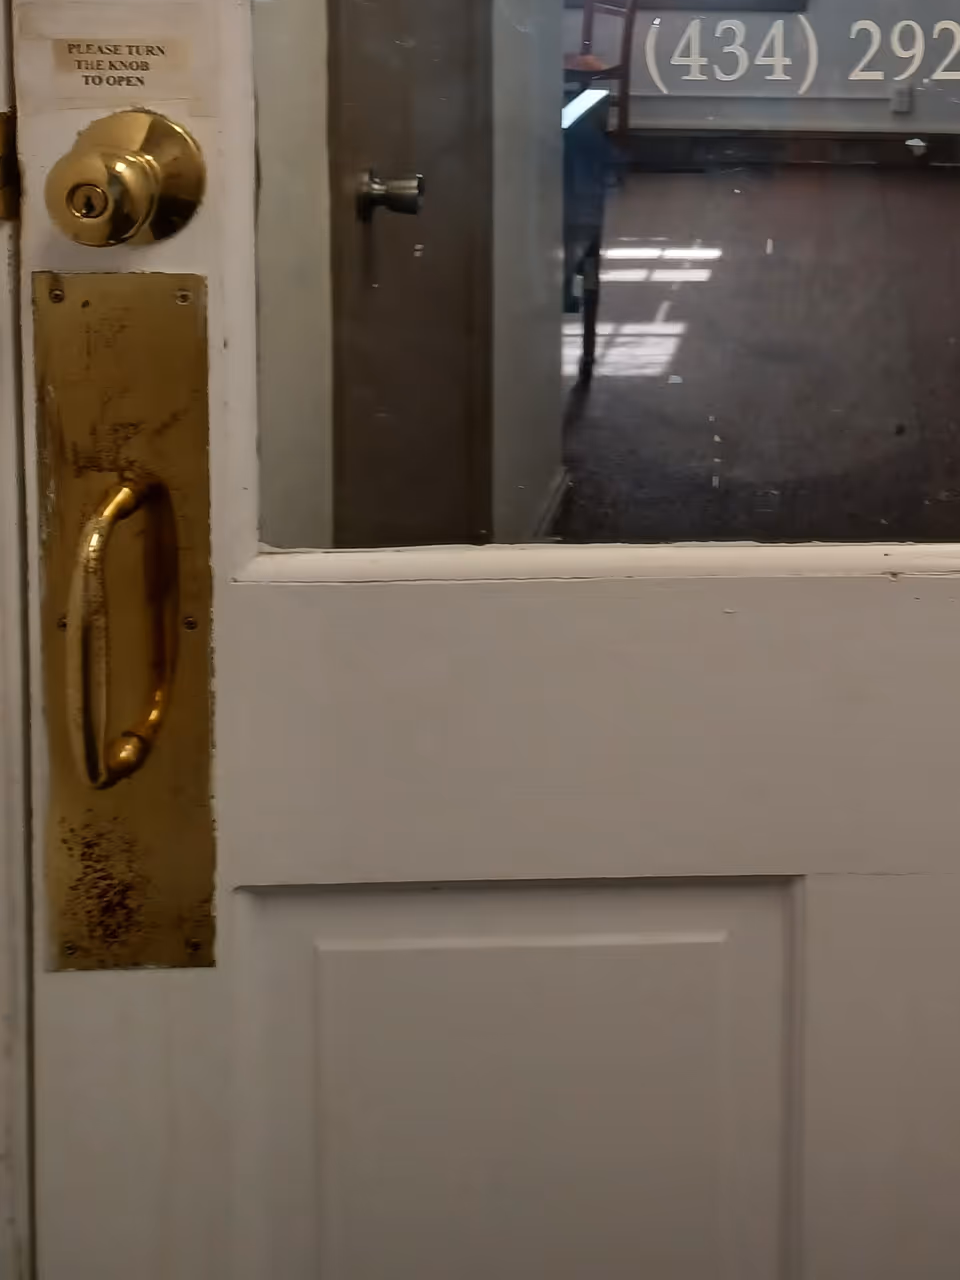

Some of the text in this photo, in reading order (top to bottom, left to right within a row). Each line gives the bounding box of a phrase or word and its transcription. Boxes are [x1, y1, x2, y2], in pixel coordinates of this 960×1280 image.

[67, 43, 167, 57] PLEASE TURN
[644, 14, 820, 96] (434)
[74, 59, 150, 72] THE KNOB
[82, 75, 146, 87] TO OPEN
